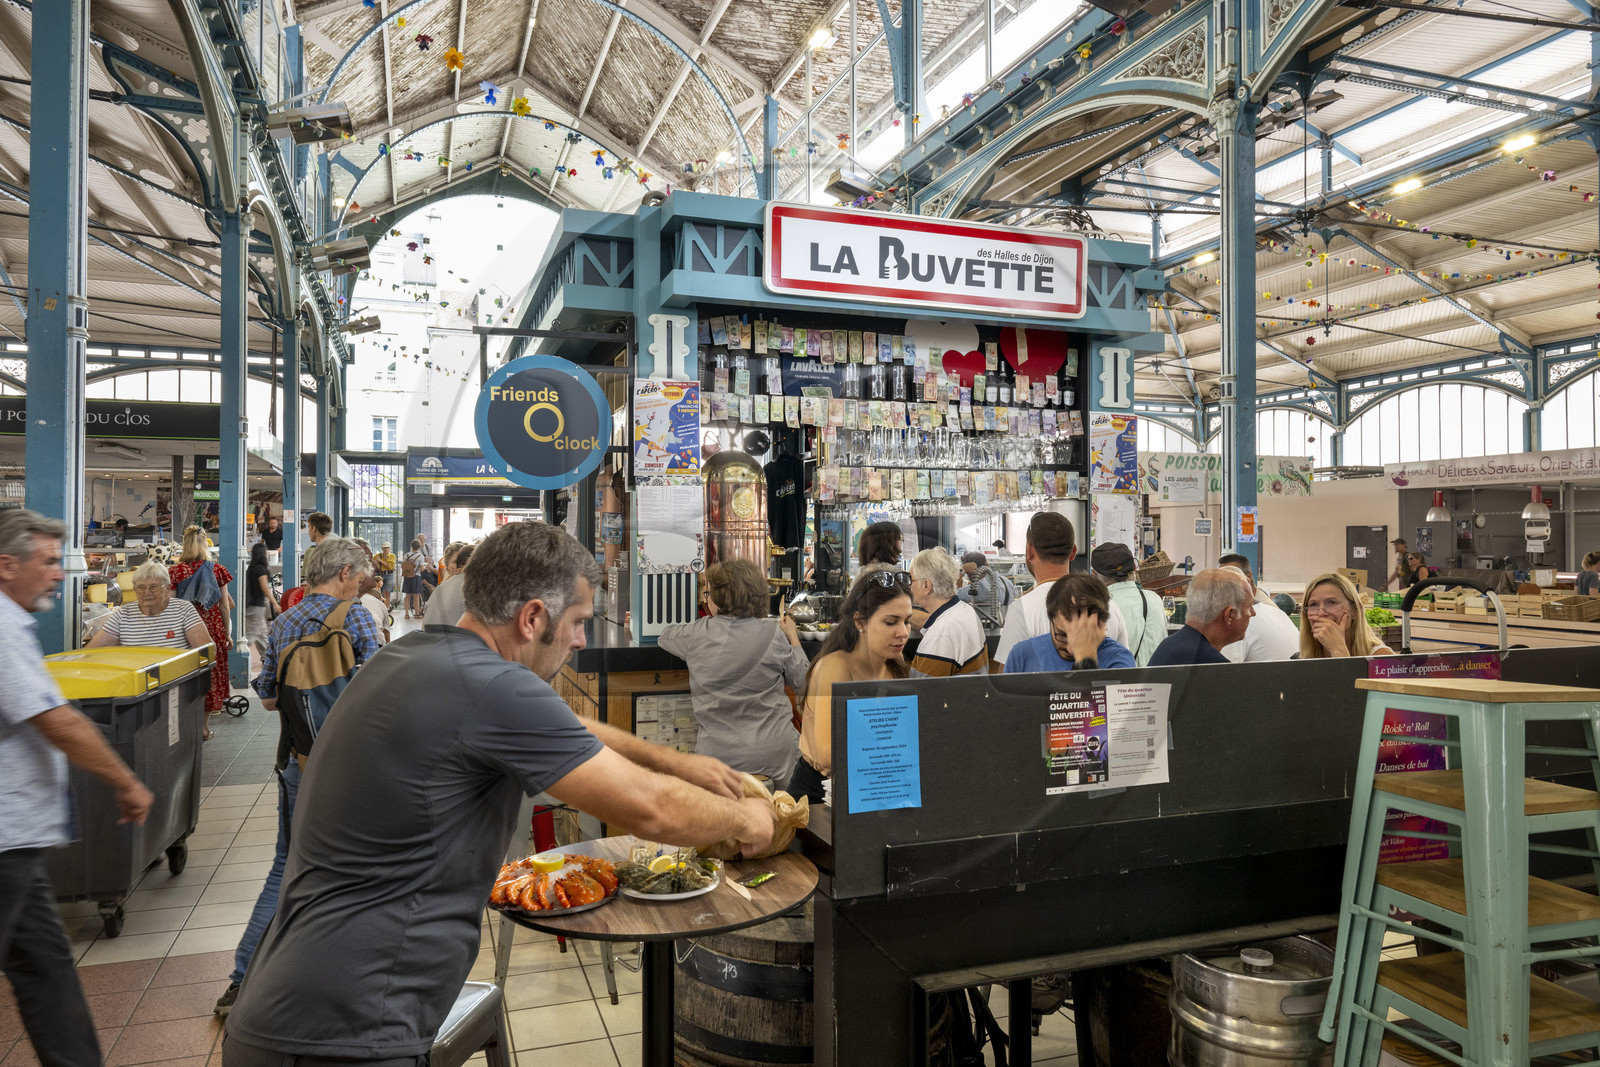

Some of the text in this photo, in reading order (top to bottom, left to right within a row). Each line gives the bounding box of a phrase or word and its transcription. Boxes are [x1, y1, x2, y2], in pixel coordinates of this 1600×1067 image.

[810, 242, 860, 276] LA
[977, 248, 1055, 266] des Halles de Dijon
[790, 359, 836, 374] LAVAZZA
[490, 386, 559, 402] Friends
[86, 412, 111, 424] DU
[554, 436, 602, 450] clock
[1540, 452, 1600, 472] Oriental
[1176, 475, 1199, 483] JARDINS
[1408, 467, 1437, 477] HALAL
[1375, 665, 1385, 675] Le
[1387, 665, 1407, 677] plaisir
[1466, 660, 1491, 670] danser
[1050, 692, 1081, 701] FÊTE DU
[1049, 701, 1090, 711] QUARTIER
[1414, 722, 1430, 731] Roll
[1379, 759, 1429, 773] Danses de bal
